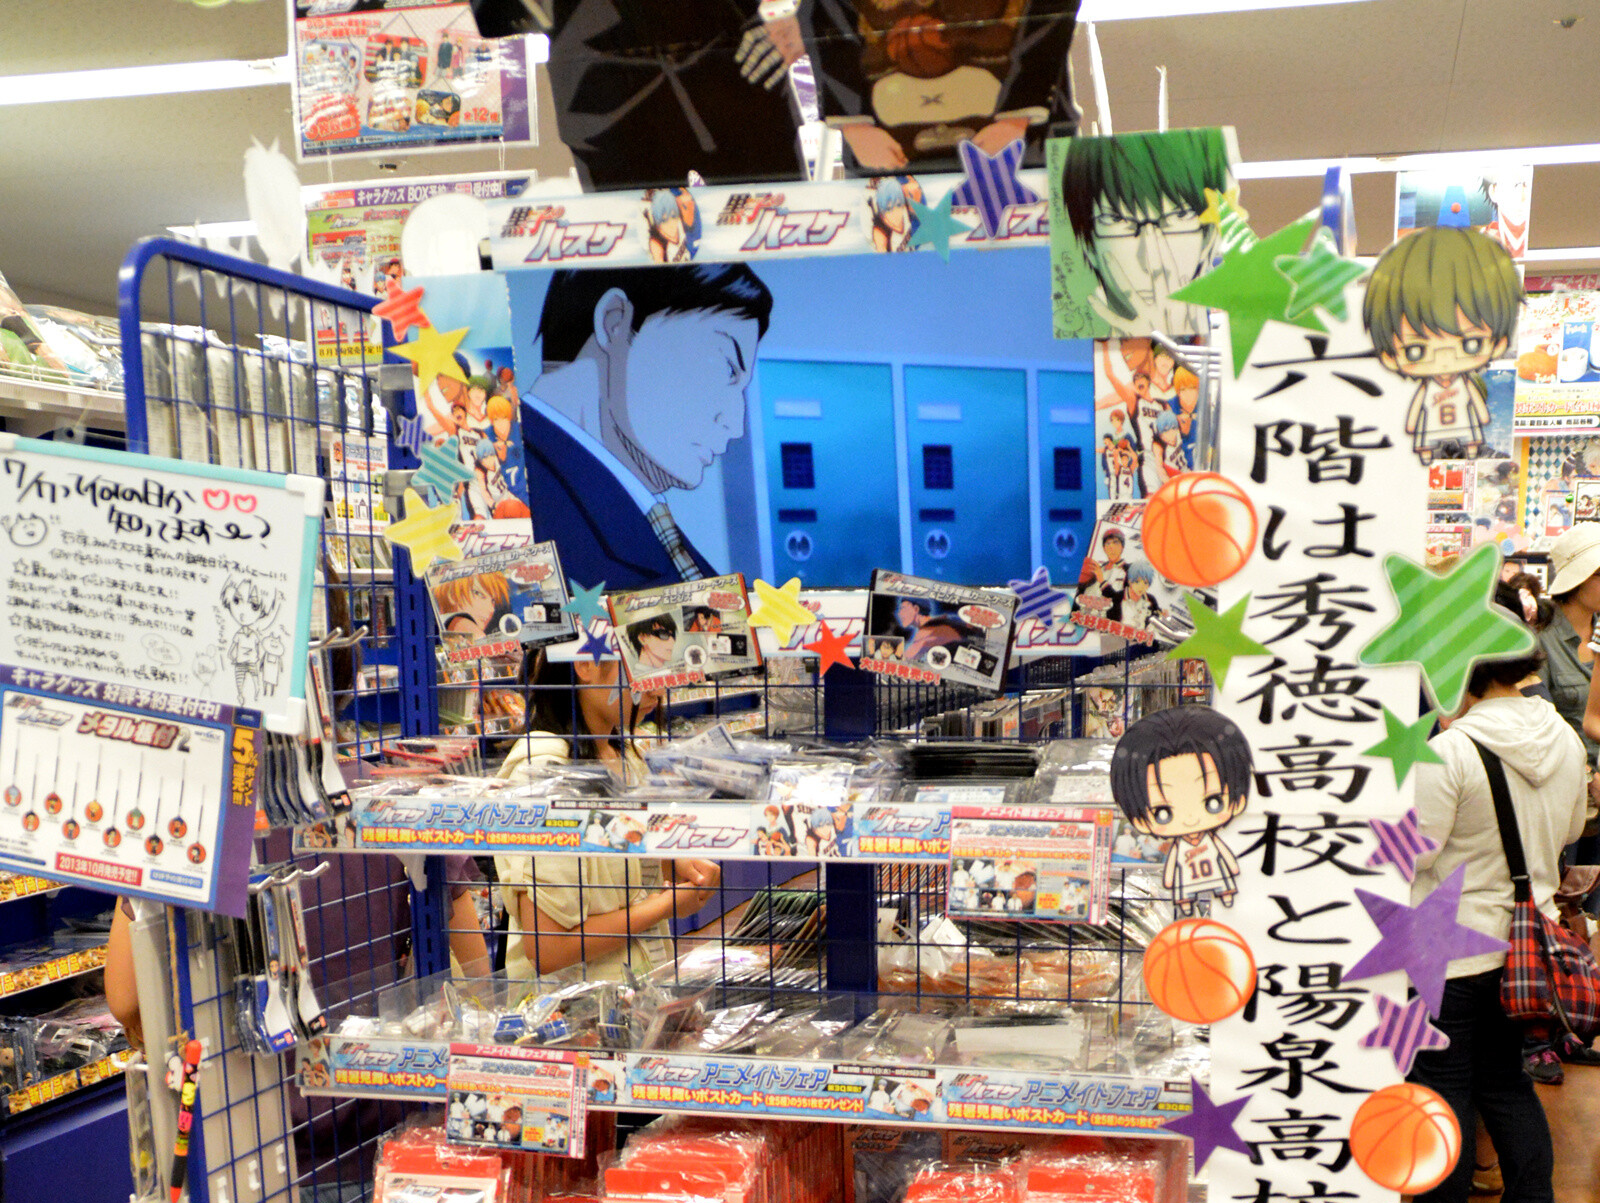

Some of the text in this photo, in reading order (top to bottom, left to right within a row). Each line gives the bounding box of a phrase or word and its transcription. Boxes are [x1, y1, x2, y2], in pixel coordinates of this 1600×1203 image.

[357, 188, 406, 204] キャラグッズ
[1068, 610, 1155, 648] 大好評発売中!
[449, 639, 523, 663] 大好評発売中!
[629, 671, 706, 694] 大好評発売中!
[859, 655, 941, 686] 大好評発売中!
[10, 667, 222, 721] キャラグッズ 好評予約受付中!
[425, 802, 549, 827] アニメイトフェア
[361, 826, 485, 846] 残暑見舞いポストカード
[1188, 858, 1213, 880] 10
[335, 1068, 449, 1089] 残暑見舞いポストカー
[699, 1062, 831, 1092] アニメイトフェア
[631, 1083, 764, 1107] 残暑見舞いポストカード
[1021, 1079, 1163, 1110] アニメイトフェア
[947, 1101, 1089, 1126] 残暑見舞いポストカード
